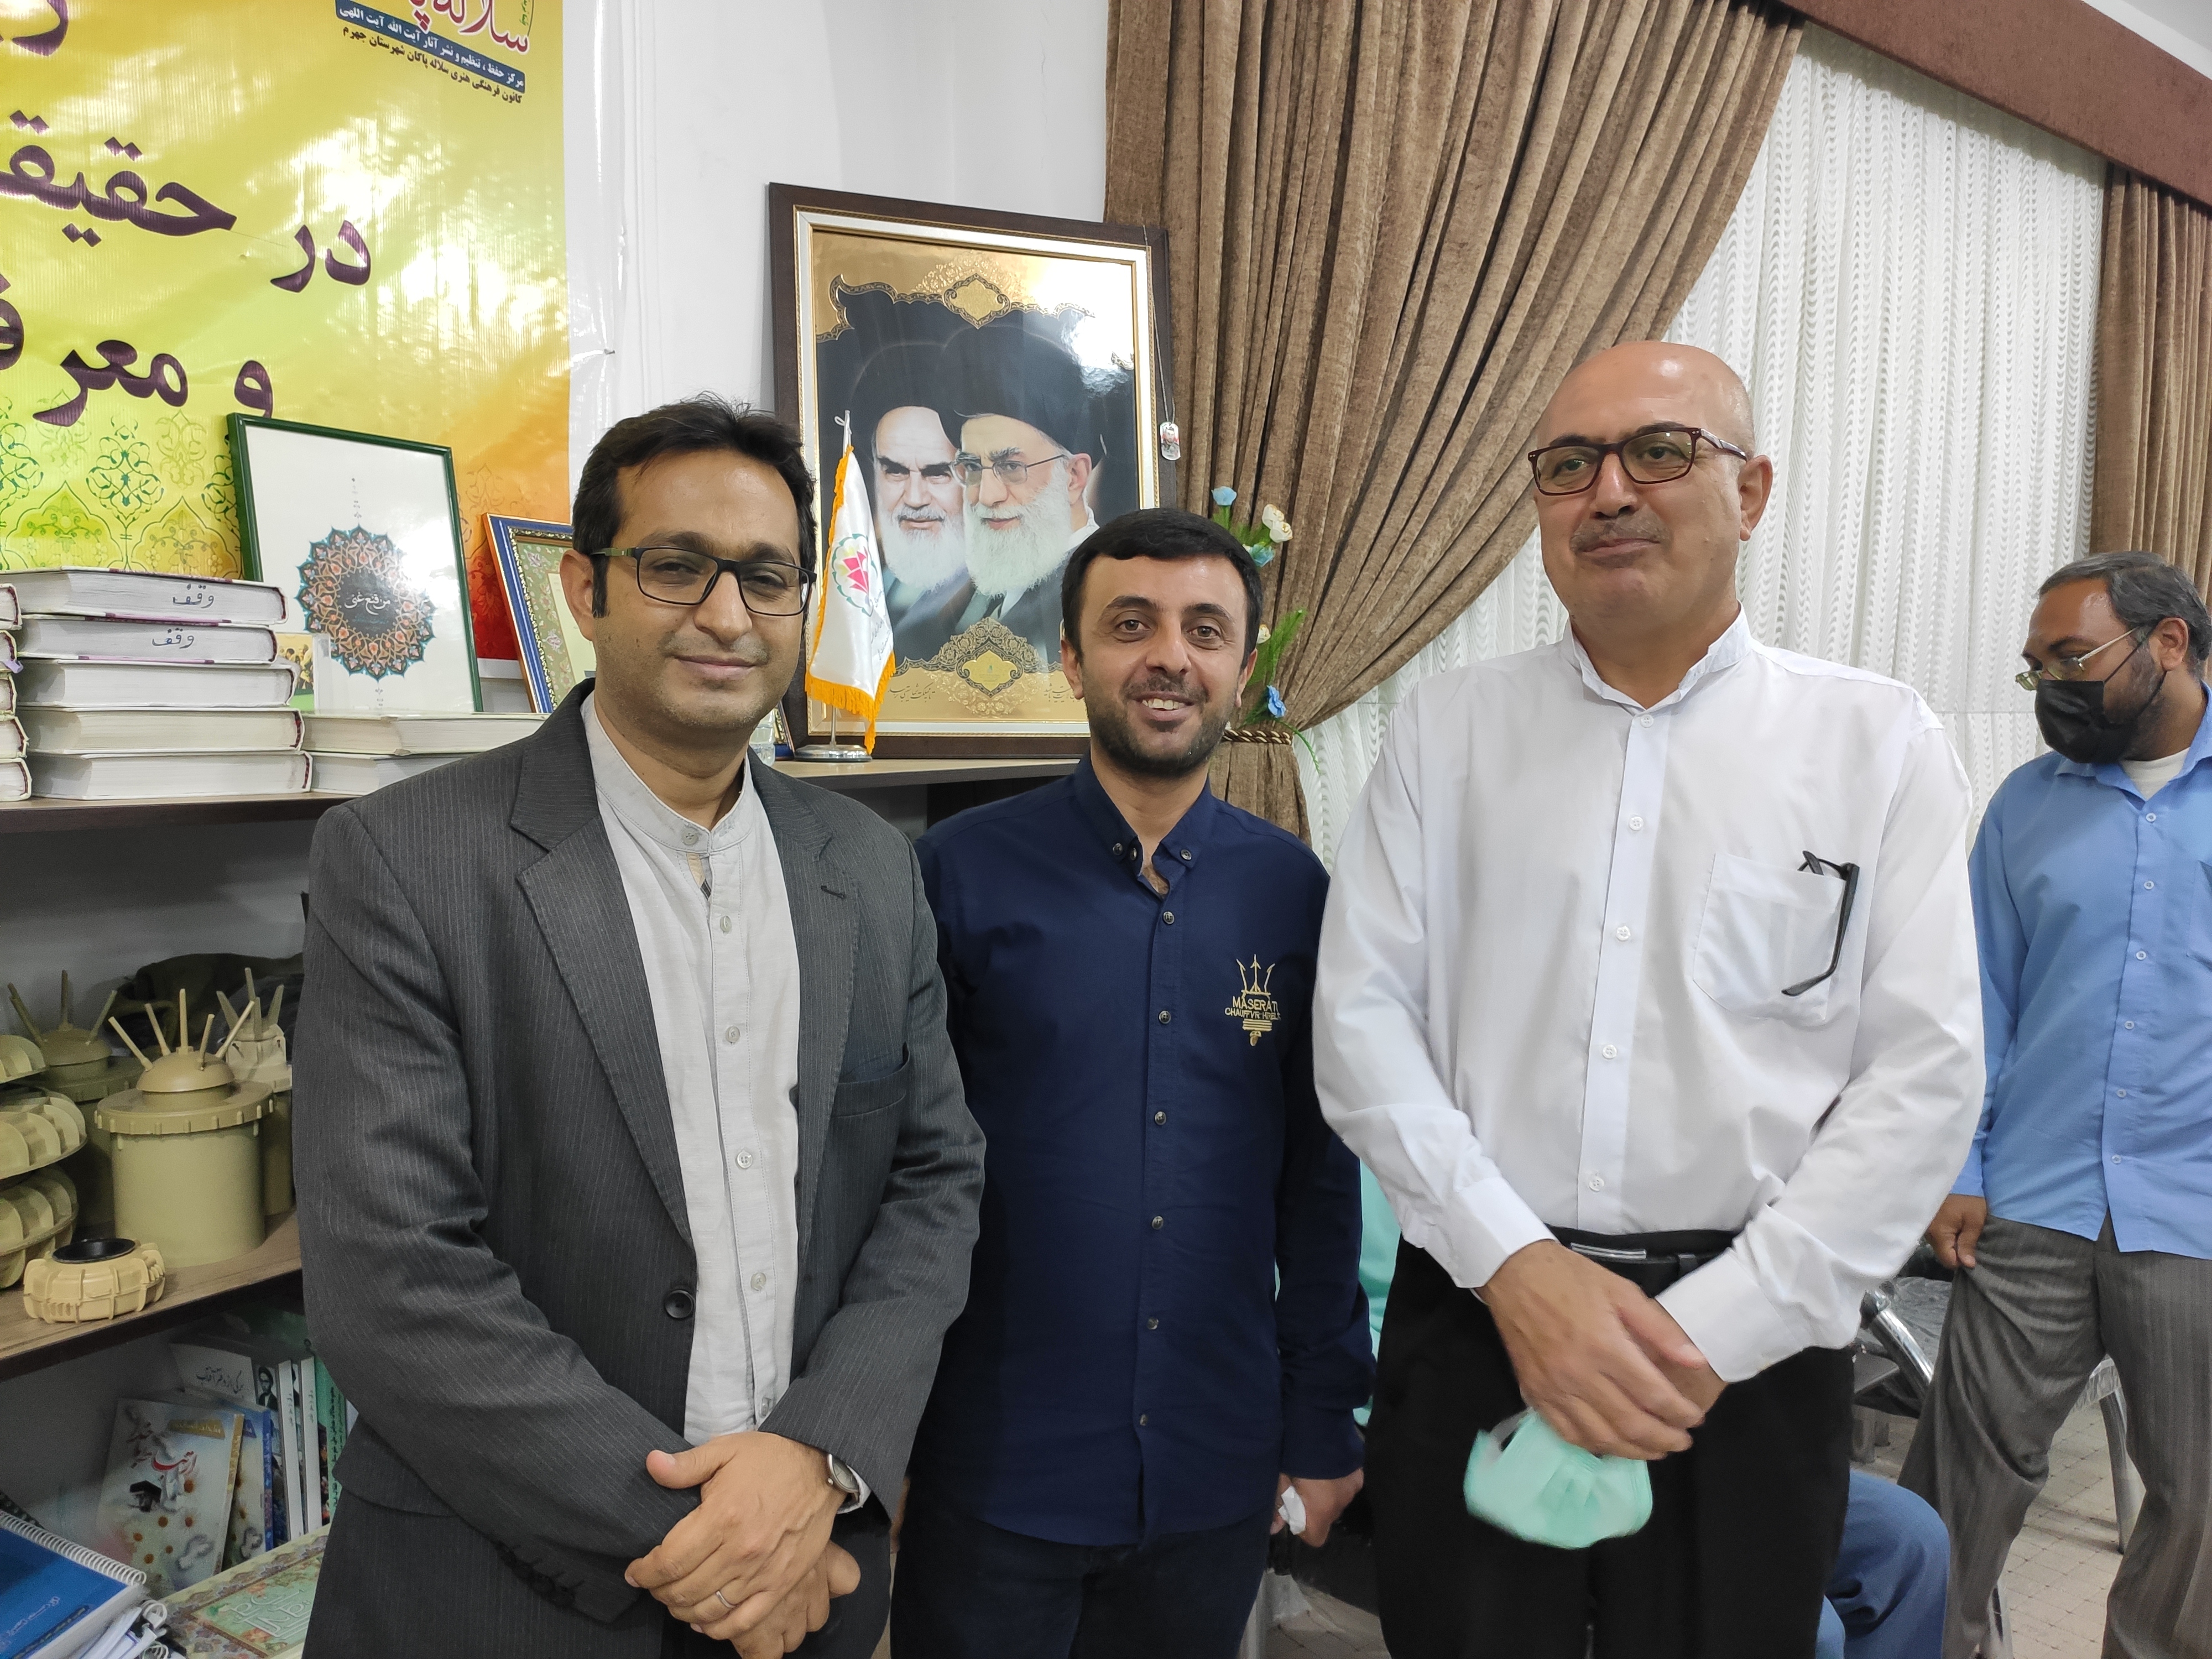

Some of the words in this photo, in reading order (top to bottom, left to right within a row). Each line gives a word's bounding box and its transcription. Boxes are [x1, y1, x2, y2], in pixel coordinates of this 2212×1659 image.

[366, 14, 384, 28] آیت
[387, 19, 402, 34] الله
[343, 27, 366, 43] جهرم
[403, 29, 421, 43] آیت
[423, 36, 439, 50] آثار
[440, 44, 454, 56] نشر
[455, 53, 460, 62] و
[407, 49, 428, 69] پاکان
[430, 58, 449, 74] سلاله
[451, 71, 470, 82] هنری
[472, 79, 500, 97] فرهنگی
[0, 109, 237, 247] حقیق
[270, 220, 371, 293] در
[234, 360, 274, 419] و
[173, 583, 215, 608] وقف
[373, 598, 391, 609] من
[152, 628, 195, 649] وقف
